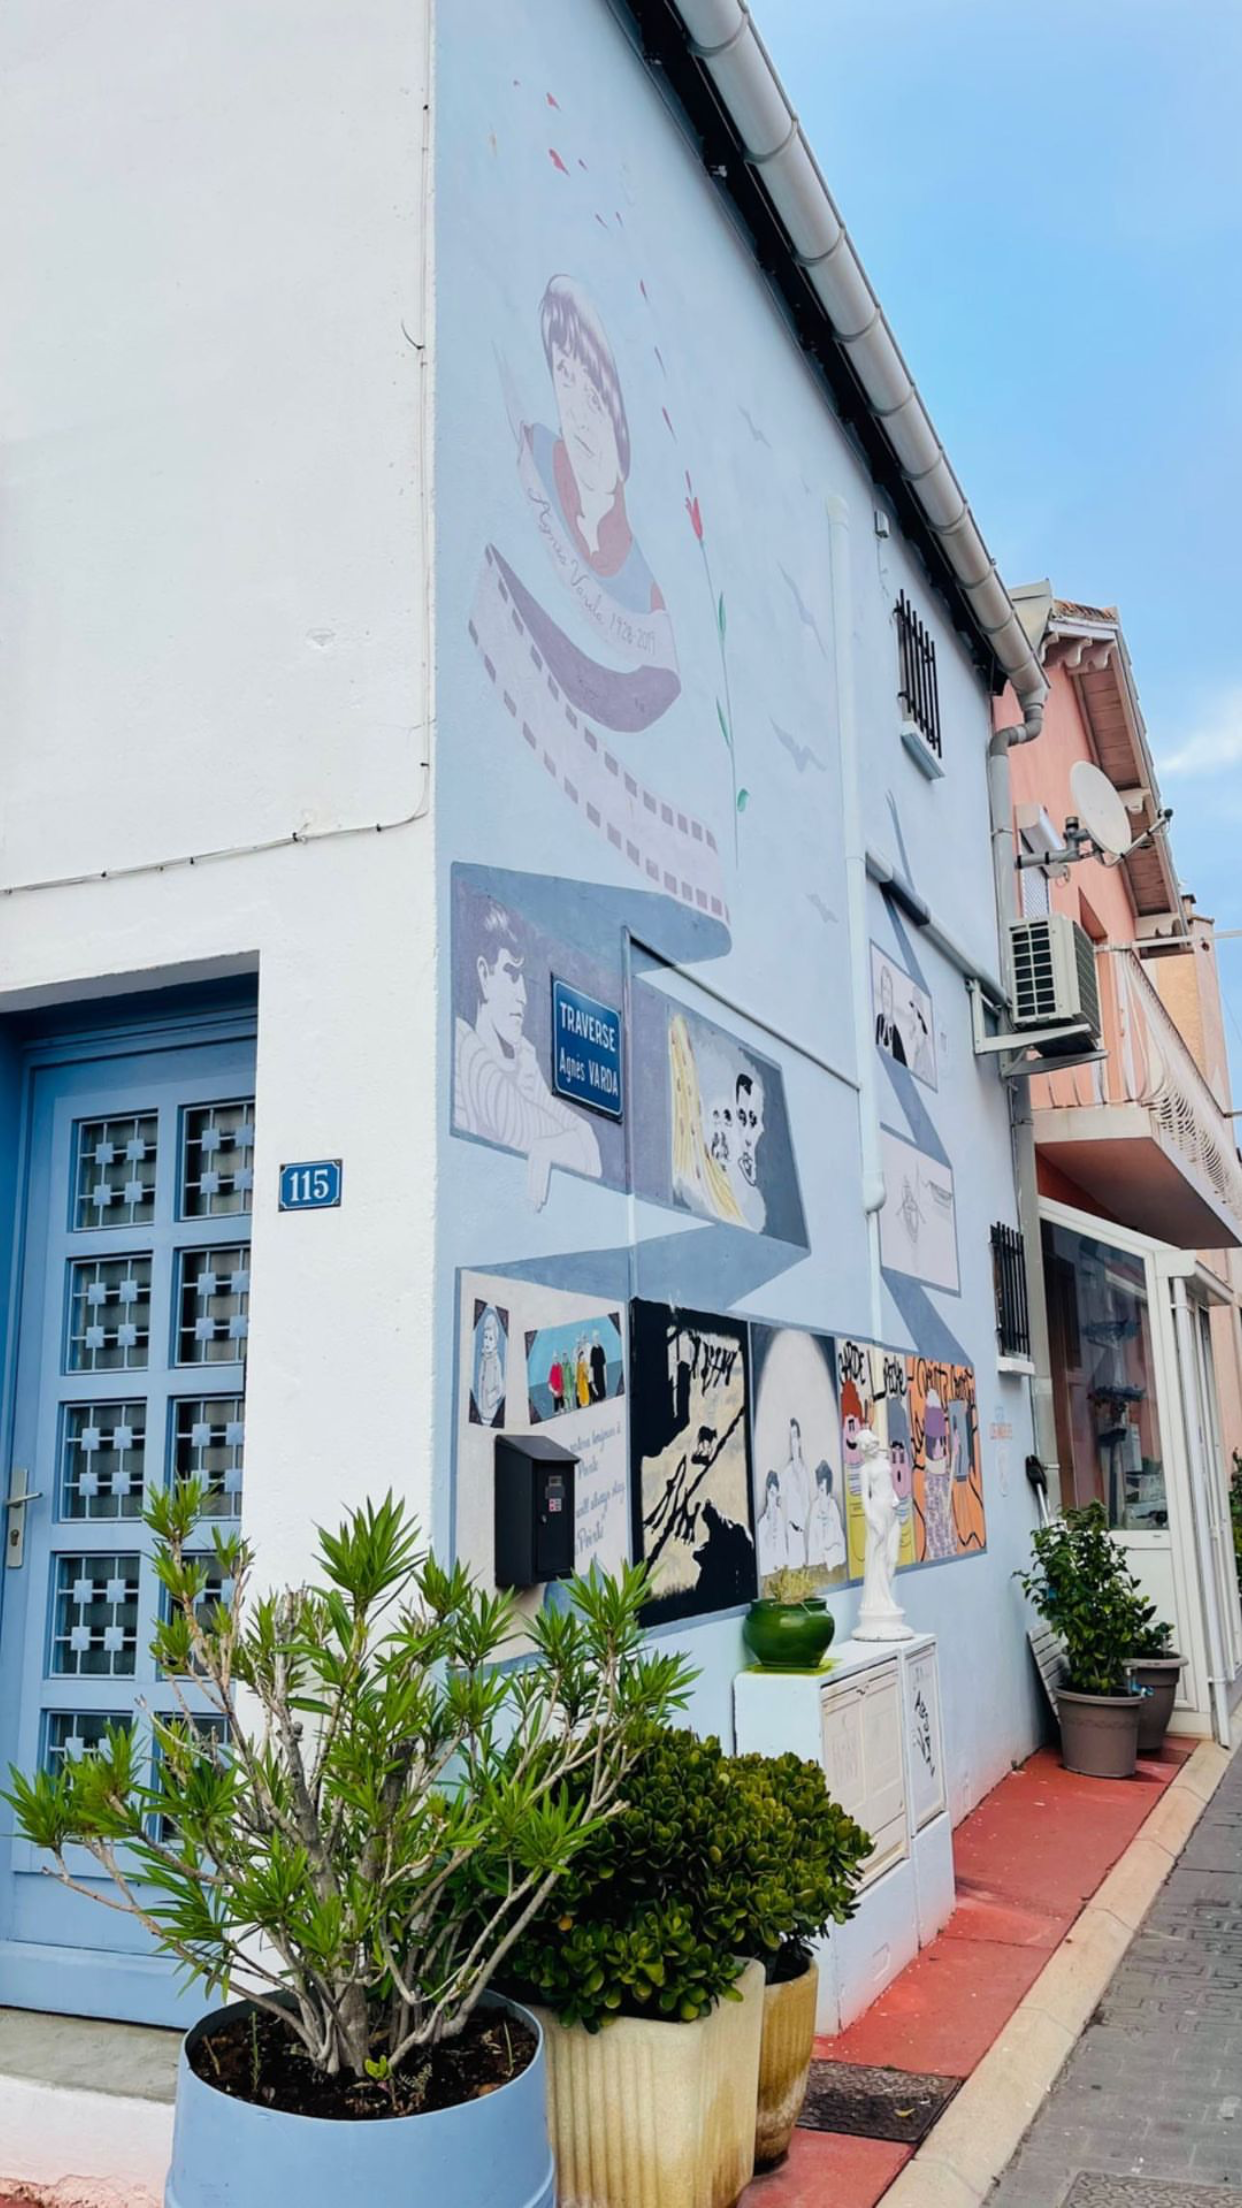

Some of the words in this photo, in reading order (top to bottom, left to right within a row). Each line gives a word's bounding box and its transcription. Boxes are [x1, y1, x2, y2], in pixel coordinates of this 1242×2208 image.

[559, 1001, 616, 1053] TRAVERSE
[588, 1060, 619, 1097] VARDA
[289, 1168, 330, 1202] 115
